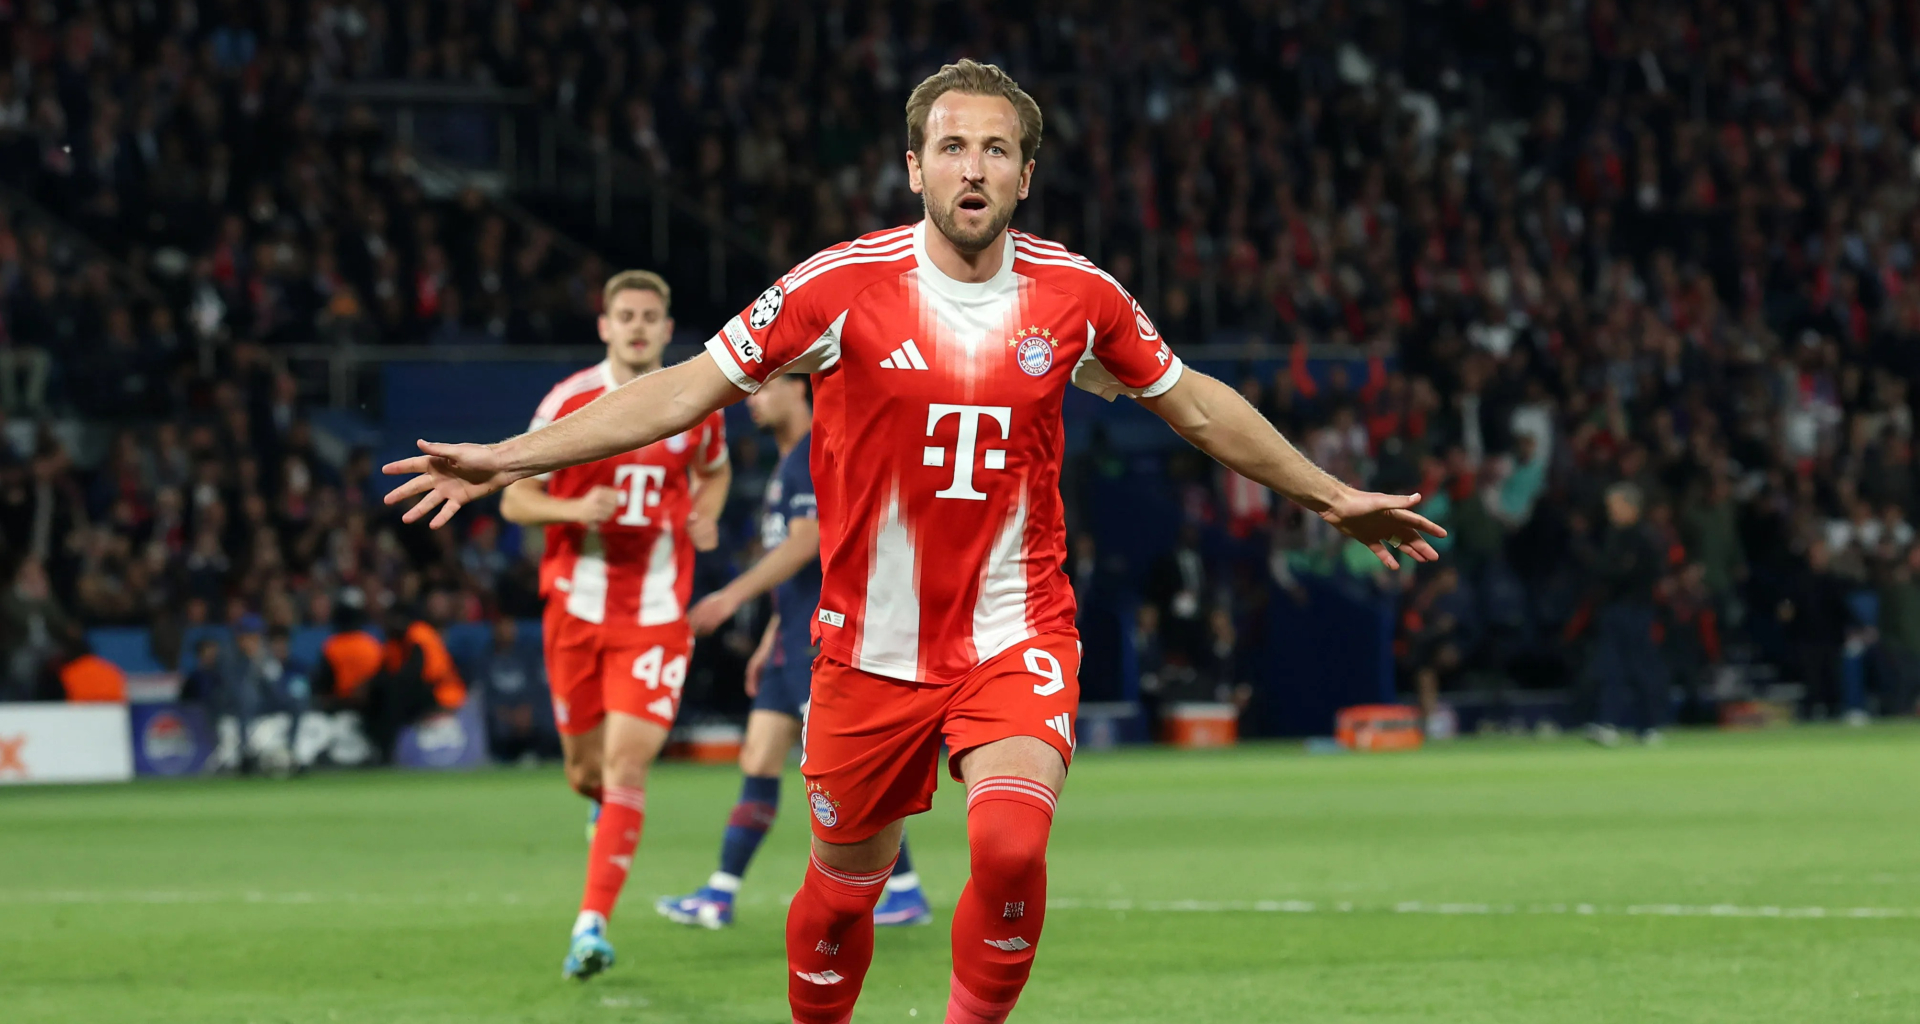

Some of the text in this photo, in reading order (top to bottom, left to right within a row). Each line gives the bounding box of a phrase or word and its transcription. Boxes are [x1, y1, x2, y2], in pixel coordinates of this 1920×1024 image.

[1020, 339, 1050, 354] FC BAYERN
[1020, 359, 1050, 374] MÜNCHEN
[923, 403, 1012, 501] T
[613, 463, 666, 527] T
[631, 645, 687, 699] 44
[1022, 647, 1065, 697] 9
